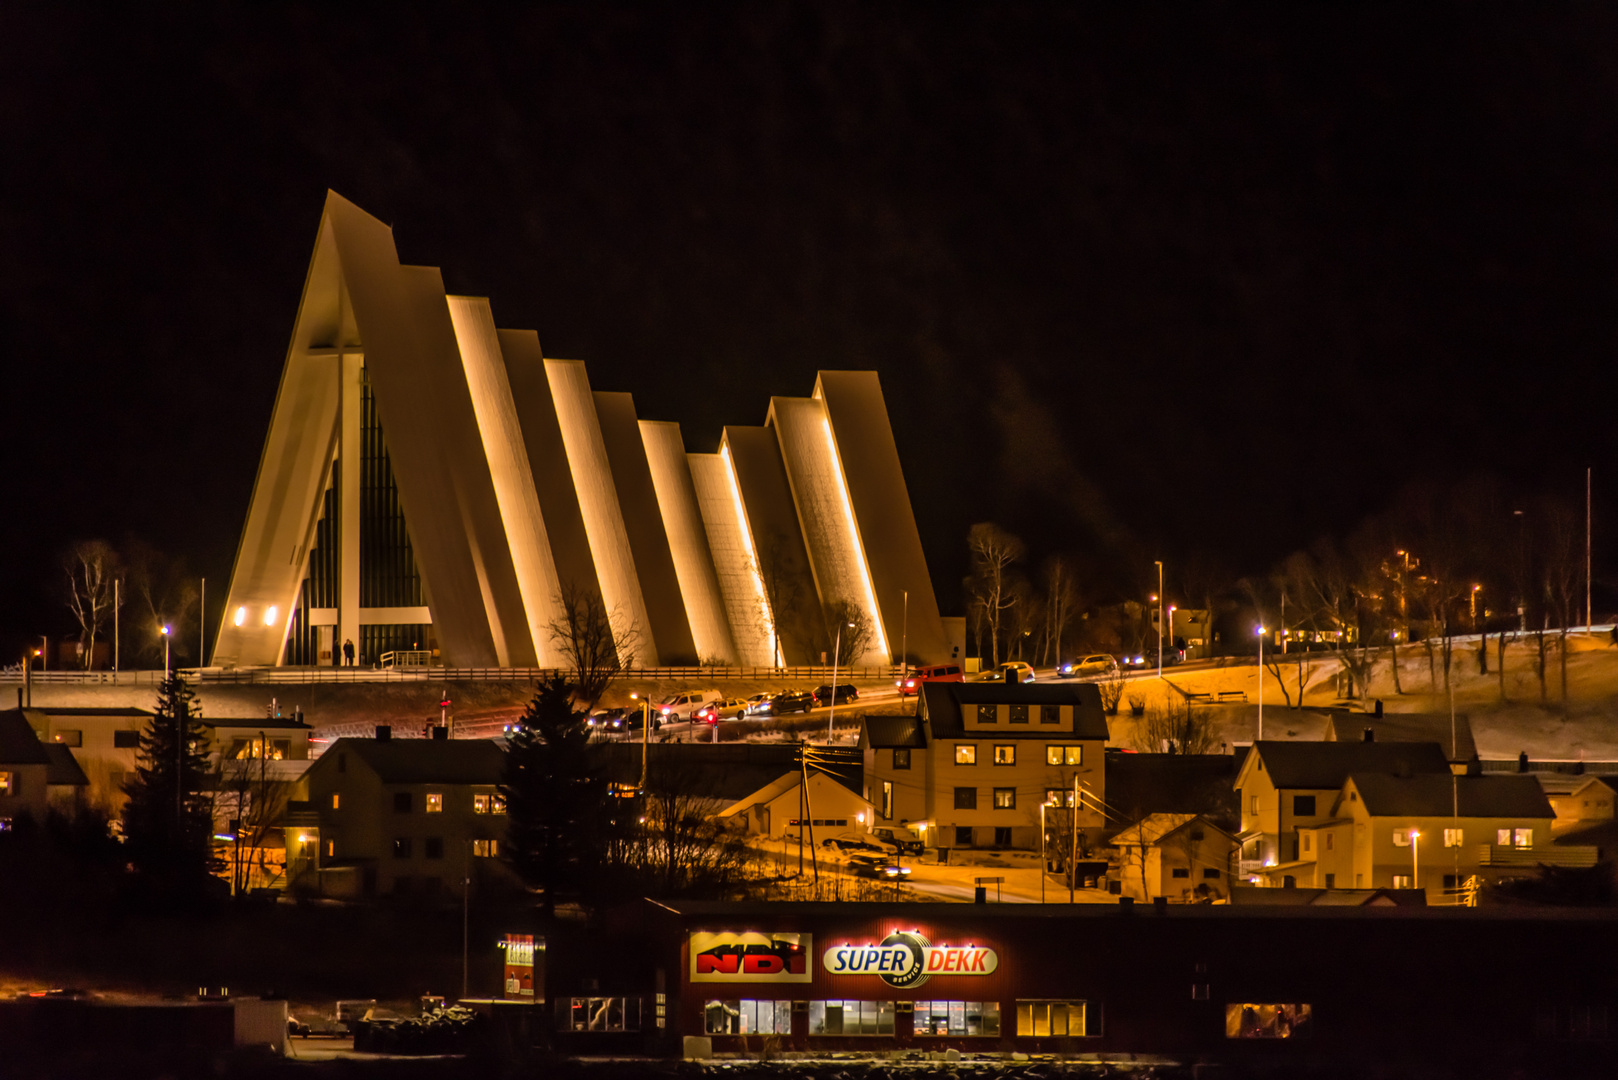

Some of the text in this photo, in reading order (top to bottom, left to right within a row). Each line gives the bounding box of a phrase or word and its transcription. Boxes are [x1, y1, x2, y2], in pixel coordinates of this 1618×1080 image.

[834, 950, 989, 972] SUPER DEKK
[892, 962, 921, 983] SERVICE
